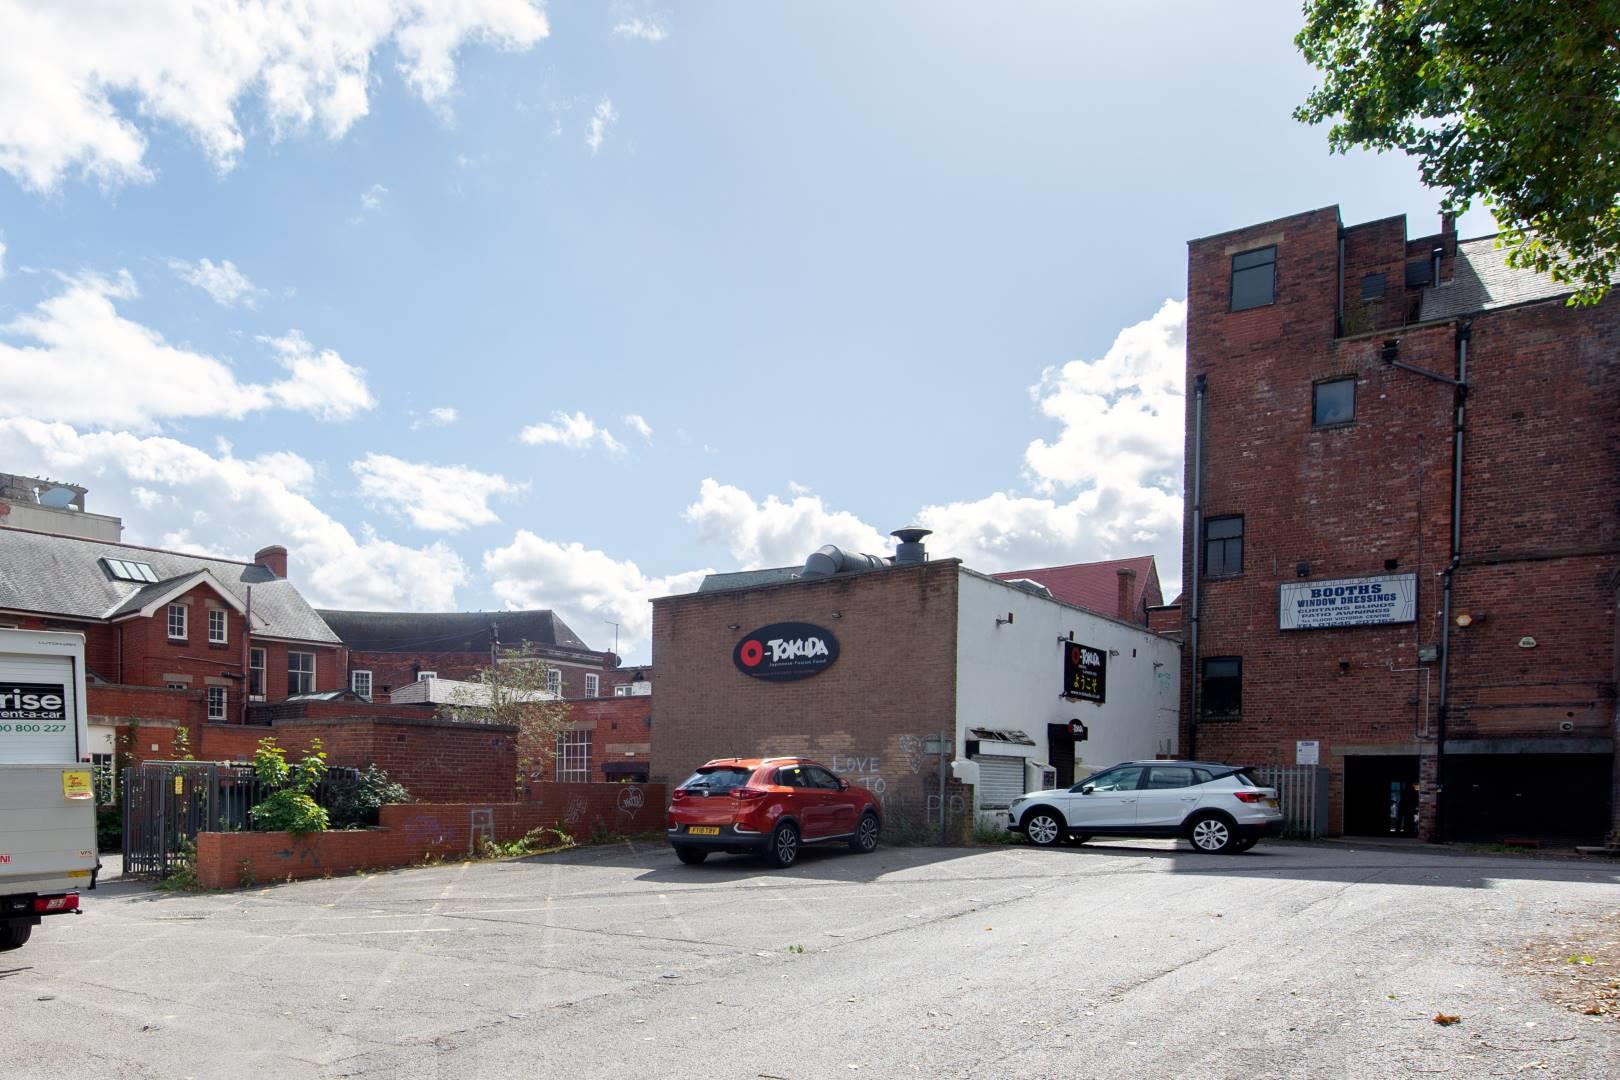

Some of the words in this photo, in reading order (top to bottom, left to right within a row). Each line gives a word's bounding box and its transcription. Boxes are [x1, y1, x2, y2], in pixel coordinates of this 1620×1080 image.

[1311, 584, 1382, 598] BOOTHS
[1297, 597, 1336, 608] WINDOW
[1340, 593, 1397, 605] DRESSINGS
[1297, 606, 1350, 614] CURTAINS
[1355, 602, 1396, 610] BLINDS
[1335, 608, 1390, 616] AWNINGS
[0, 688, 62, 710] rise
[0, 710, 63, 719] ent-a-car
[15, 724, 40, 733] 800
[43, 724, 66, 733] 227
[832, 756, 880, 772] LOVE
